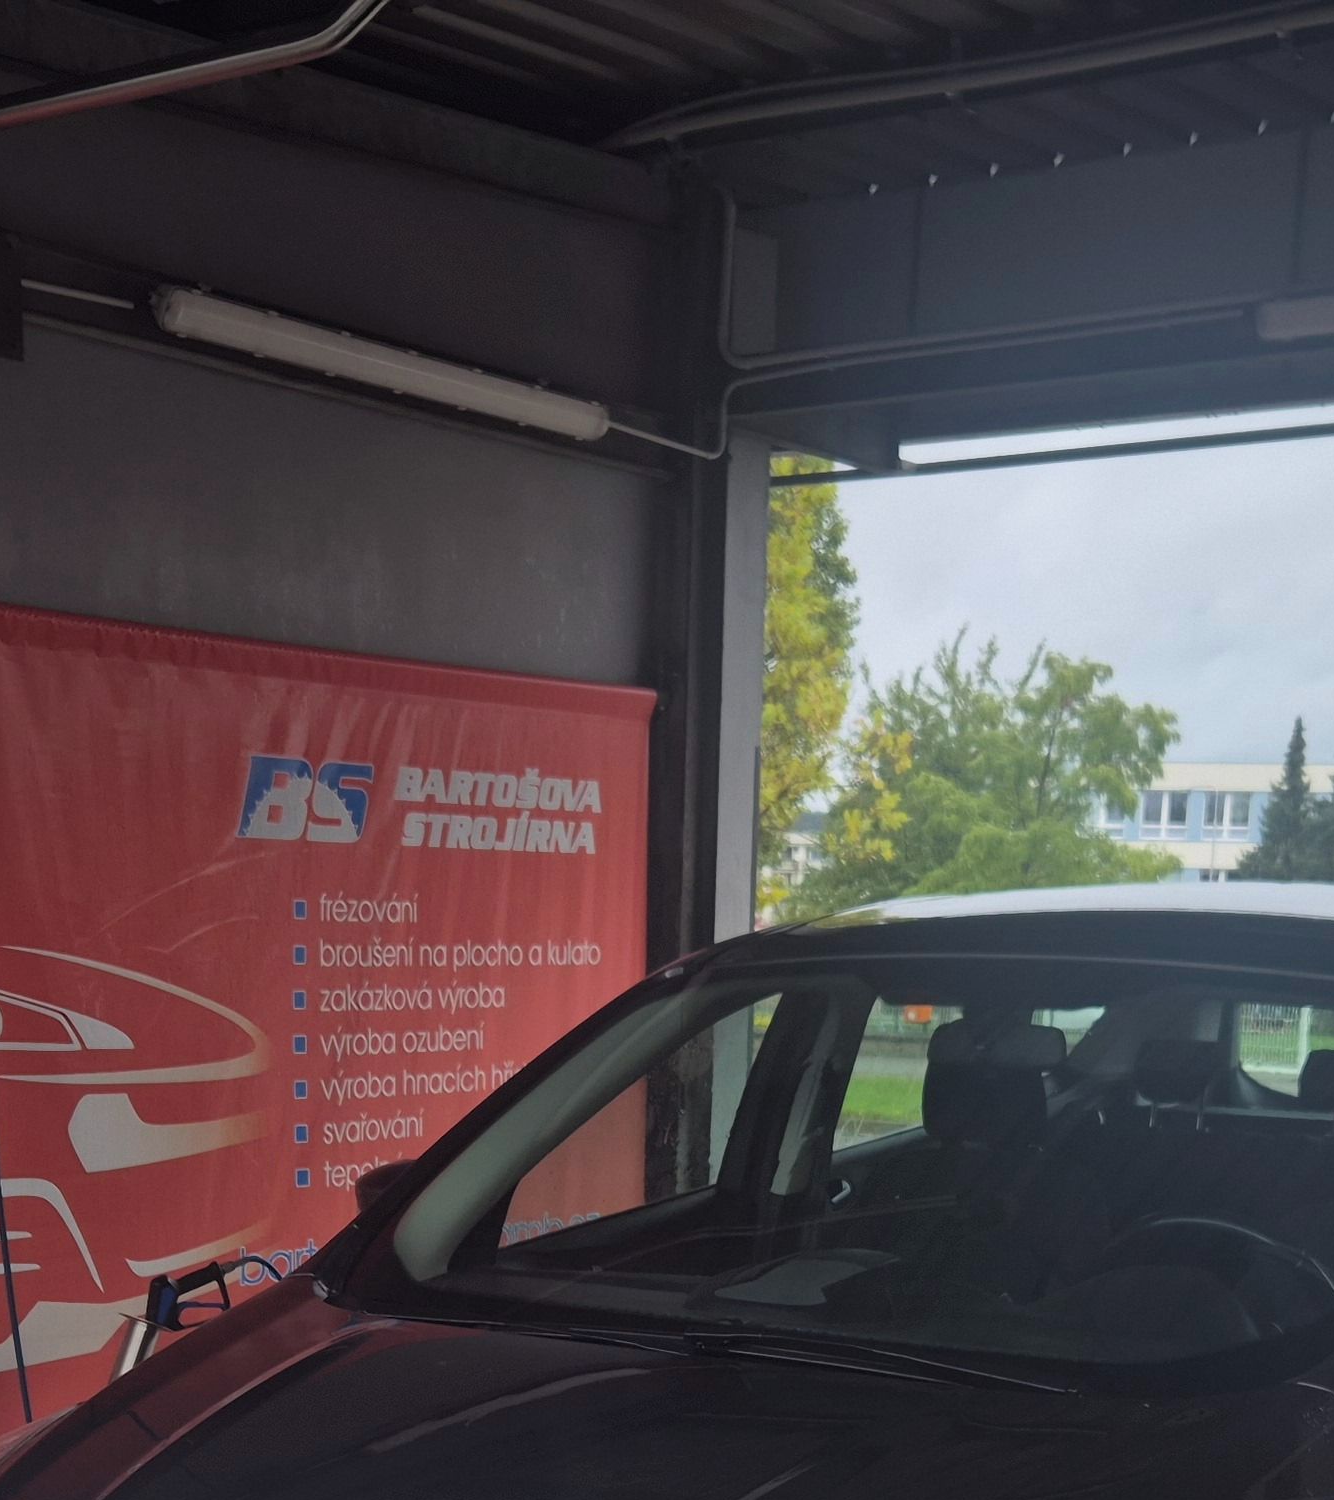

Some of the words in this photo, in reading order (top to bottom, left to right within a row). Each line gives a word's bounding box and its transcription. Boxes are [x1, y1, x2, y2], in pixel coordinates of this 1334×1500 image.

[236, 754, 375, 844] BS
[393, 766, 602, 814] BARTOŠOVA
[400, 810, 596, 855] STROJÍRNA
[319, 891, 419, 923] frézování
[319, 937, 414, 967] broušení
[419, 946, 447, 967] na
[453, 939, 524, 973] plocho
[528, 946, 543, 966] a
[547, 938, 603, 967] kulato
[319, 980, 433, 1013] zakázková
[438, 979, 506, 1015] výroba
[319, 1026, 397, 1063] výroba
[402, 1021, 485, 1054] ozubení
[319, 1070, 397, 1107] výroba
[402, 1064, 487, 1096] hnacích
[323, 1107, 425, 1145] svařování
